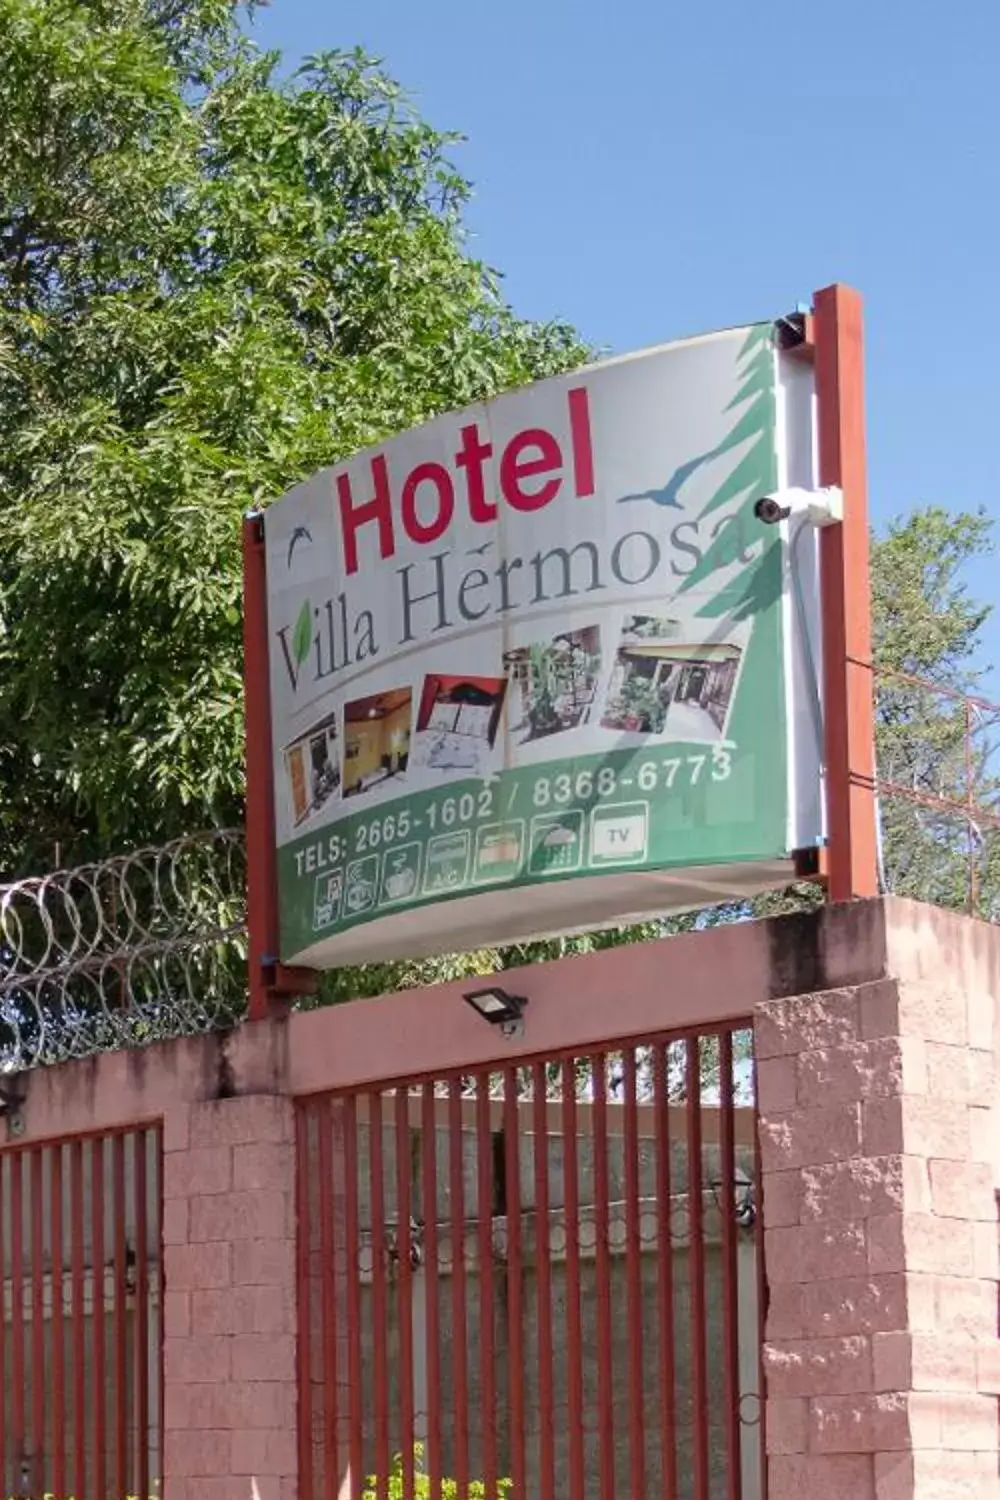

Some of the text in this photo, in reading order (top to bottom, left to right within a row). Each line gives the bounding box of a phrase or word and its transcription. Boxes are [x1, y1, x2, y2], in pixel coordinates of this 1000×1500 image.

[336, 387, 595, 576] Hotel
[276, 592, 379, 692] Villa
[294, 834, 347, 877] TELS:
[355, 790, 492, 852] 2665-1602
[532, 751, 731, 806] 8368-6773
[608, 828, 630, 844] TV
